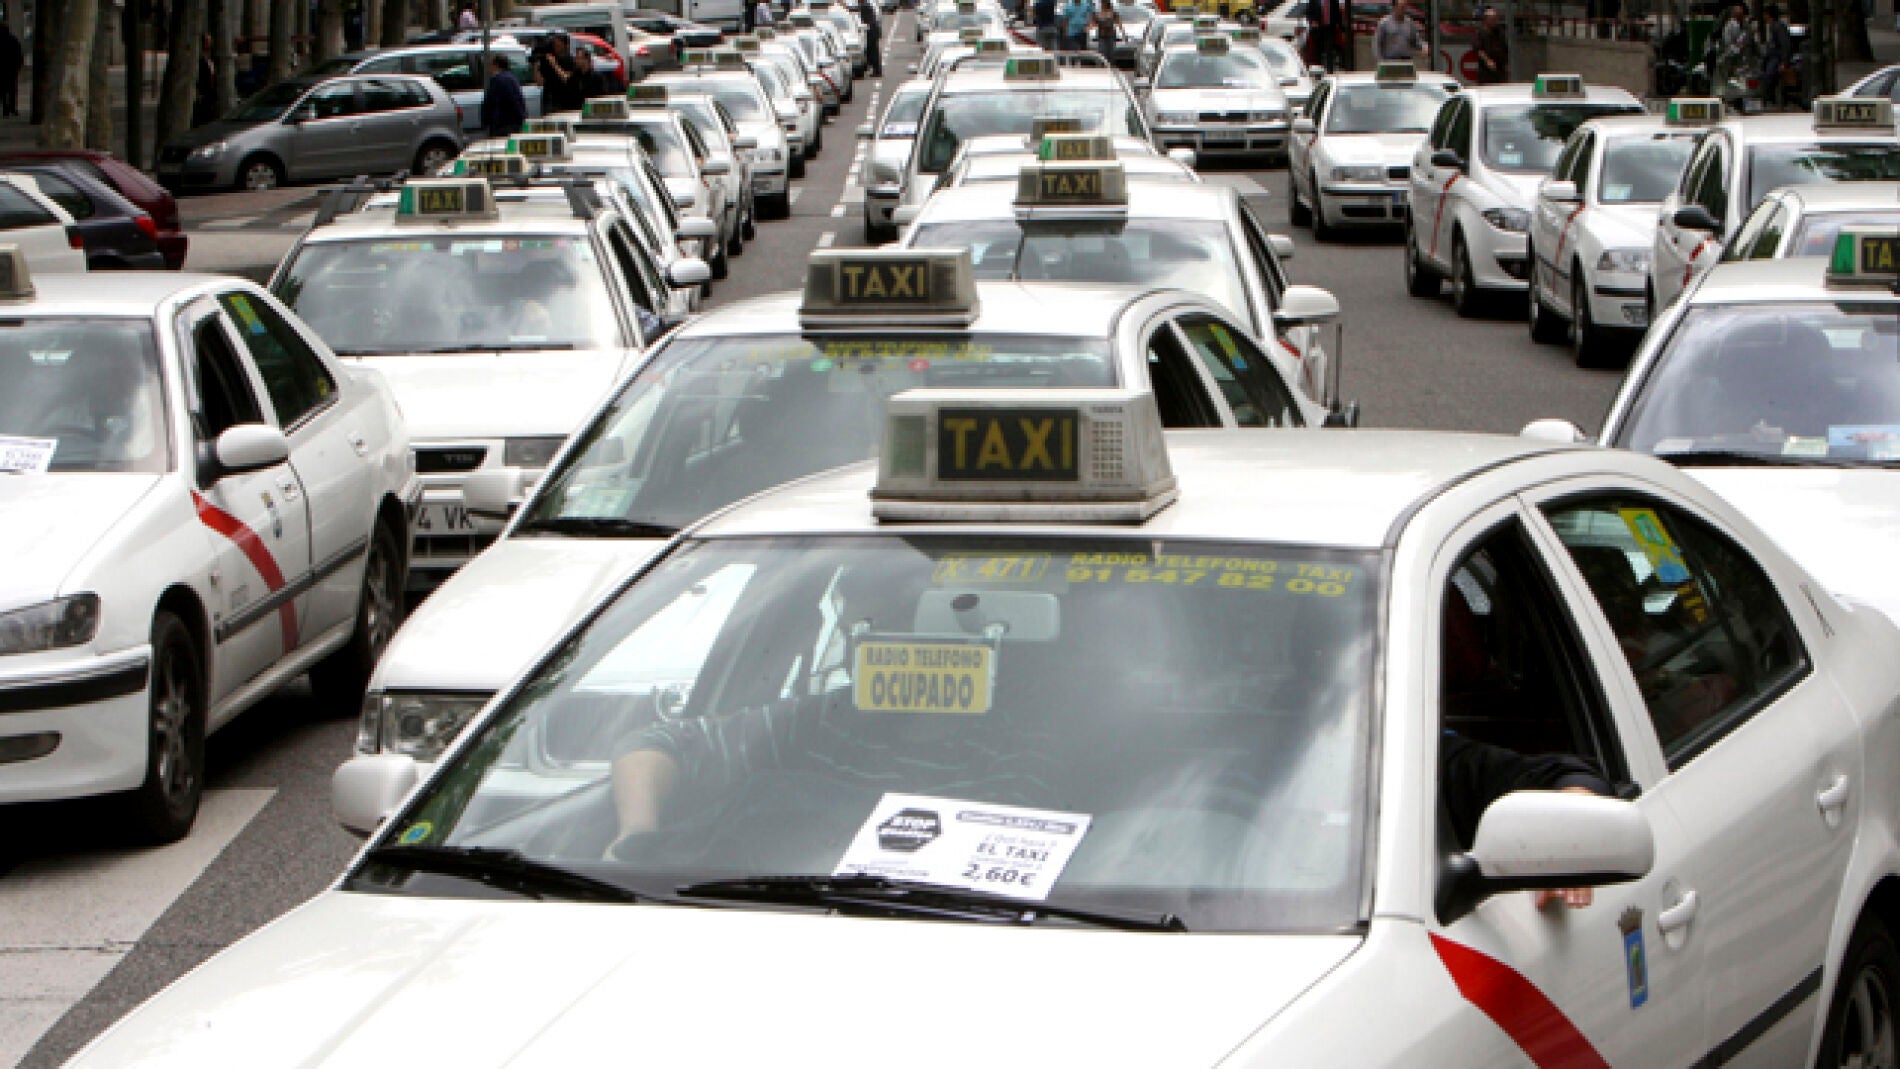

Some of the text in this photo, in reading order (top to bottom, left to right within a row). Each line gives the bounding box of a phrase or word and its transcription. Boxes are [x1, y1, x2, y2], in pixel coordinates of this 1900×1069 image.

[1839, 104, 1873, 120] TAXI
[1044, 173, 1099, 194] TAXI
[420, 189, 462, 211] TAXI
[1864, 238, 1900, 272] TA
[842, 265, 925, 298] TAXI
[943, 417, 1073, 470] TAXI
[978, 555, 1035, 577] 471
[1070, 551, 1354, 584] RADIO TELEFONO TAXI
[1065, 566, 1346, 598] 91 547 82 00
[866, 646, 983, 669] RADIO TELEFONO
[871, 670, 974, 709] OCUPADO
[976, 842, 996, 856] EL
[1005, 845, 1051, 862] TAXI
[962, 862, 1037, 887] 2,60€
